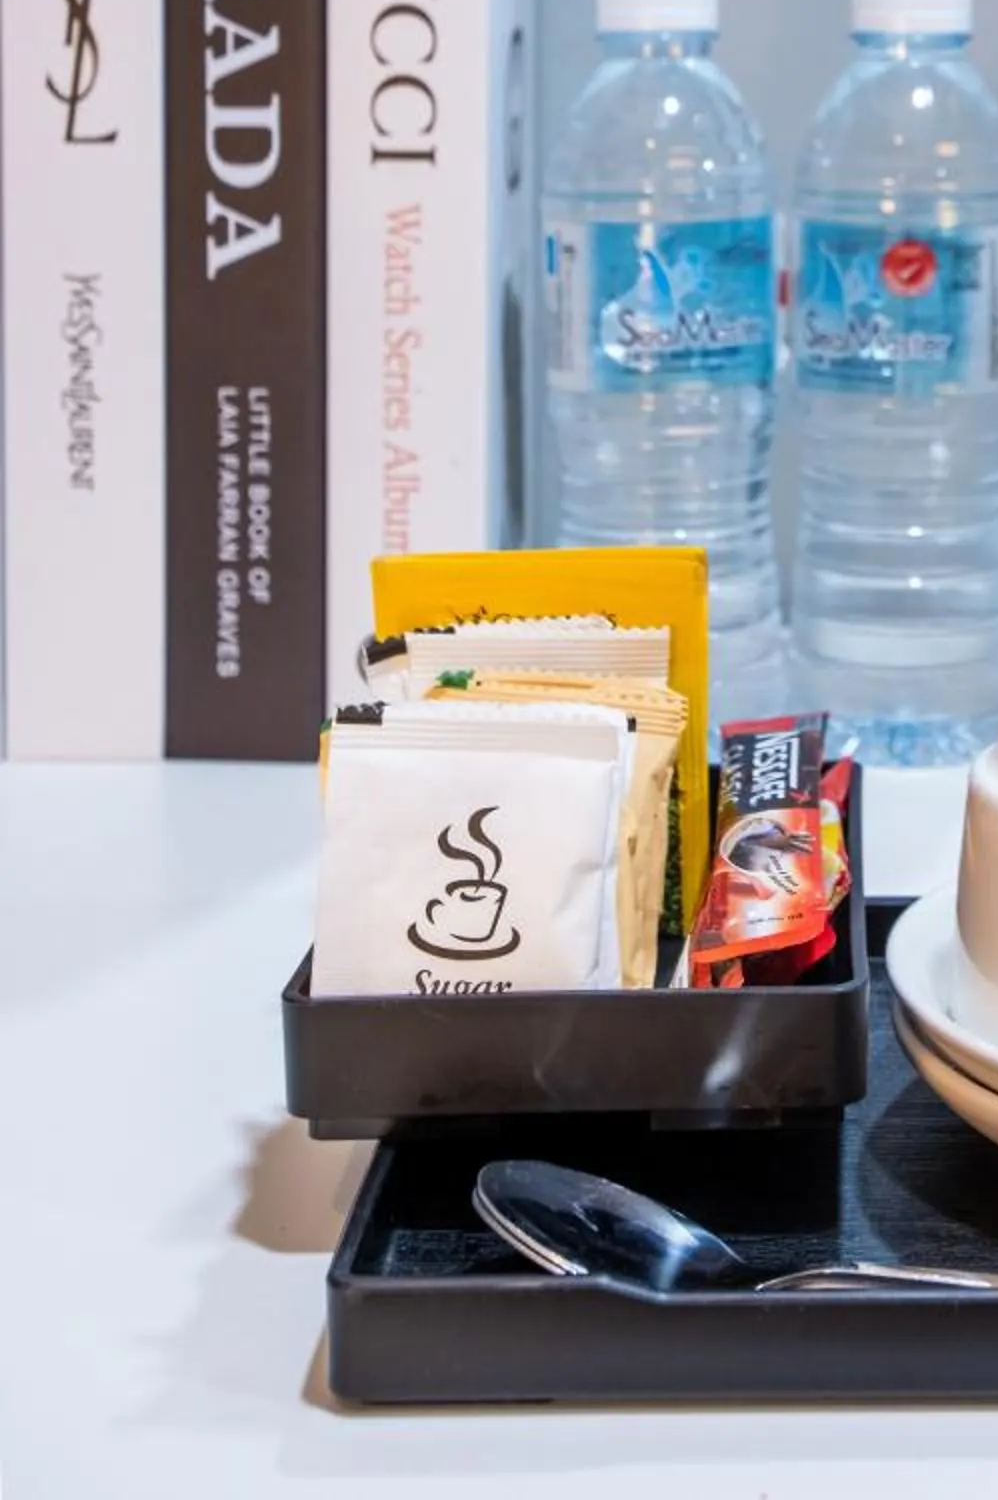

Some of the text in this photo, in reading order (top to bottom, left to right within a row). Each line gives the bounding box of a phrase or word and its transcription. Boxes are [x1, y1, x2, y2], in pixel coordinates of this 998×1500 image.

[383, 201, 424, 316] Watch
[382, 327, 422, 432] Series
[216, 386, 241, 678] LAIA FARRAN GRAVES
[247, 387, 271, 604] LITTLE BOOK OF
